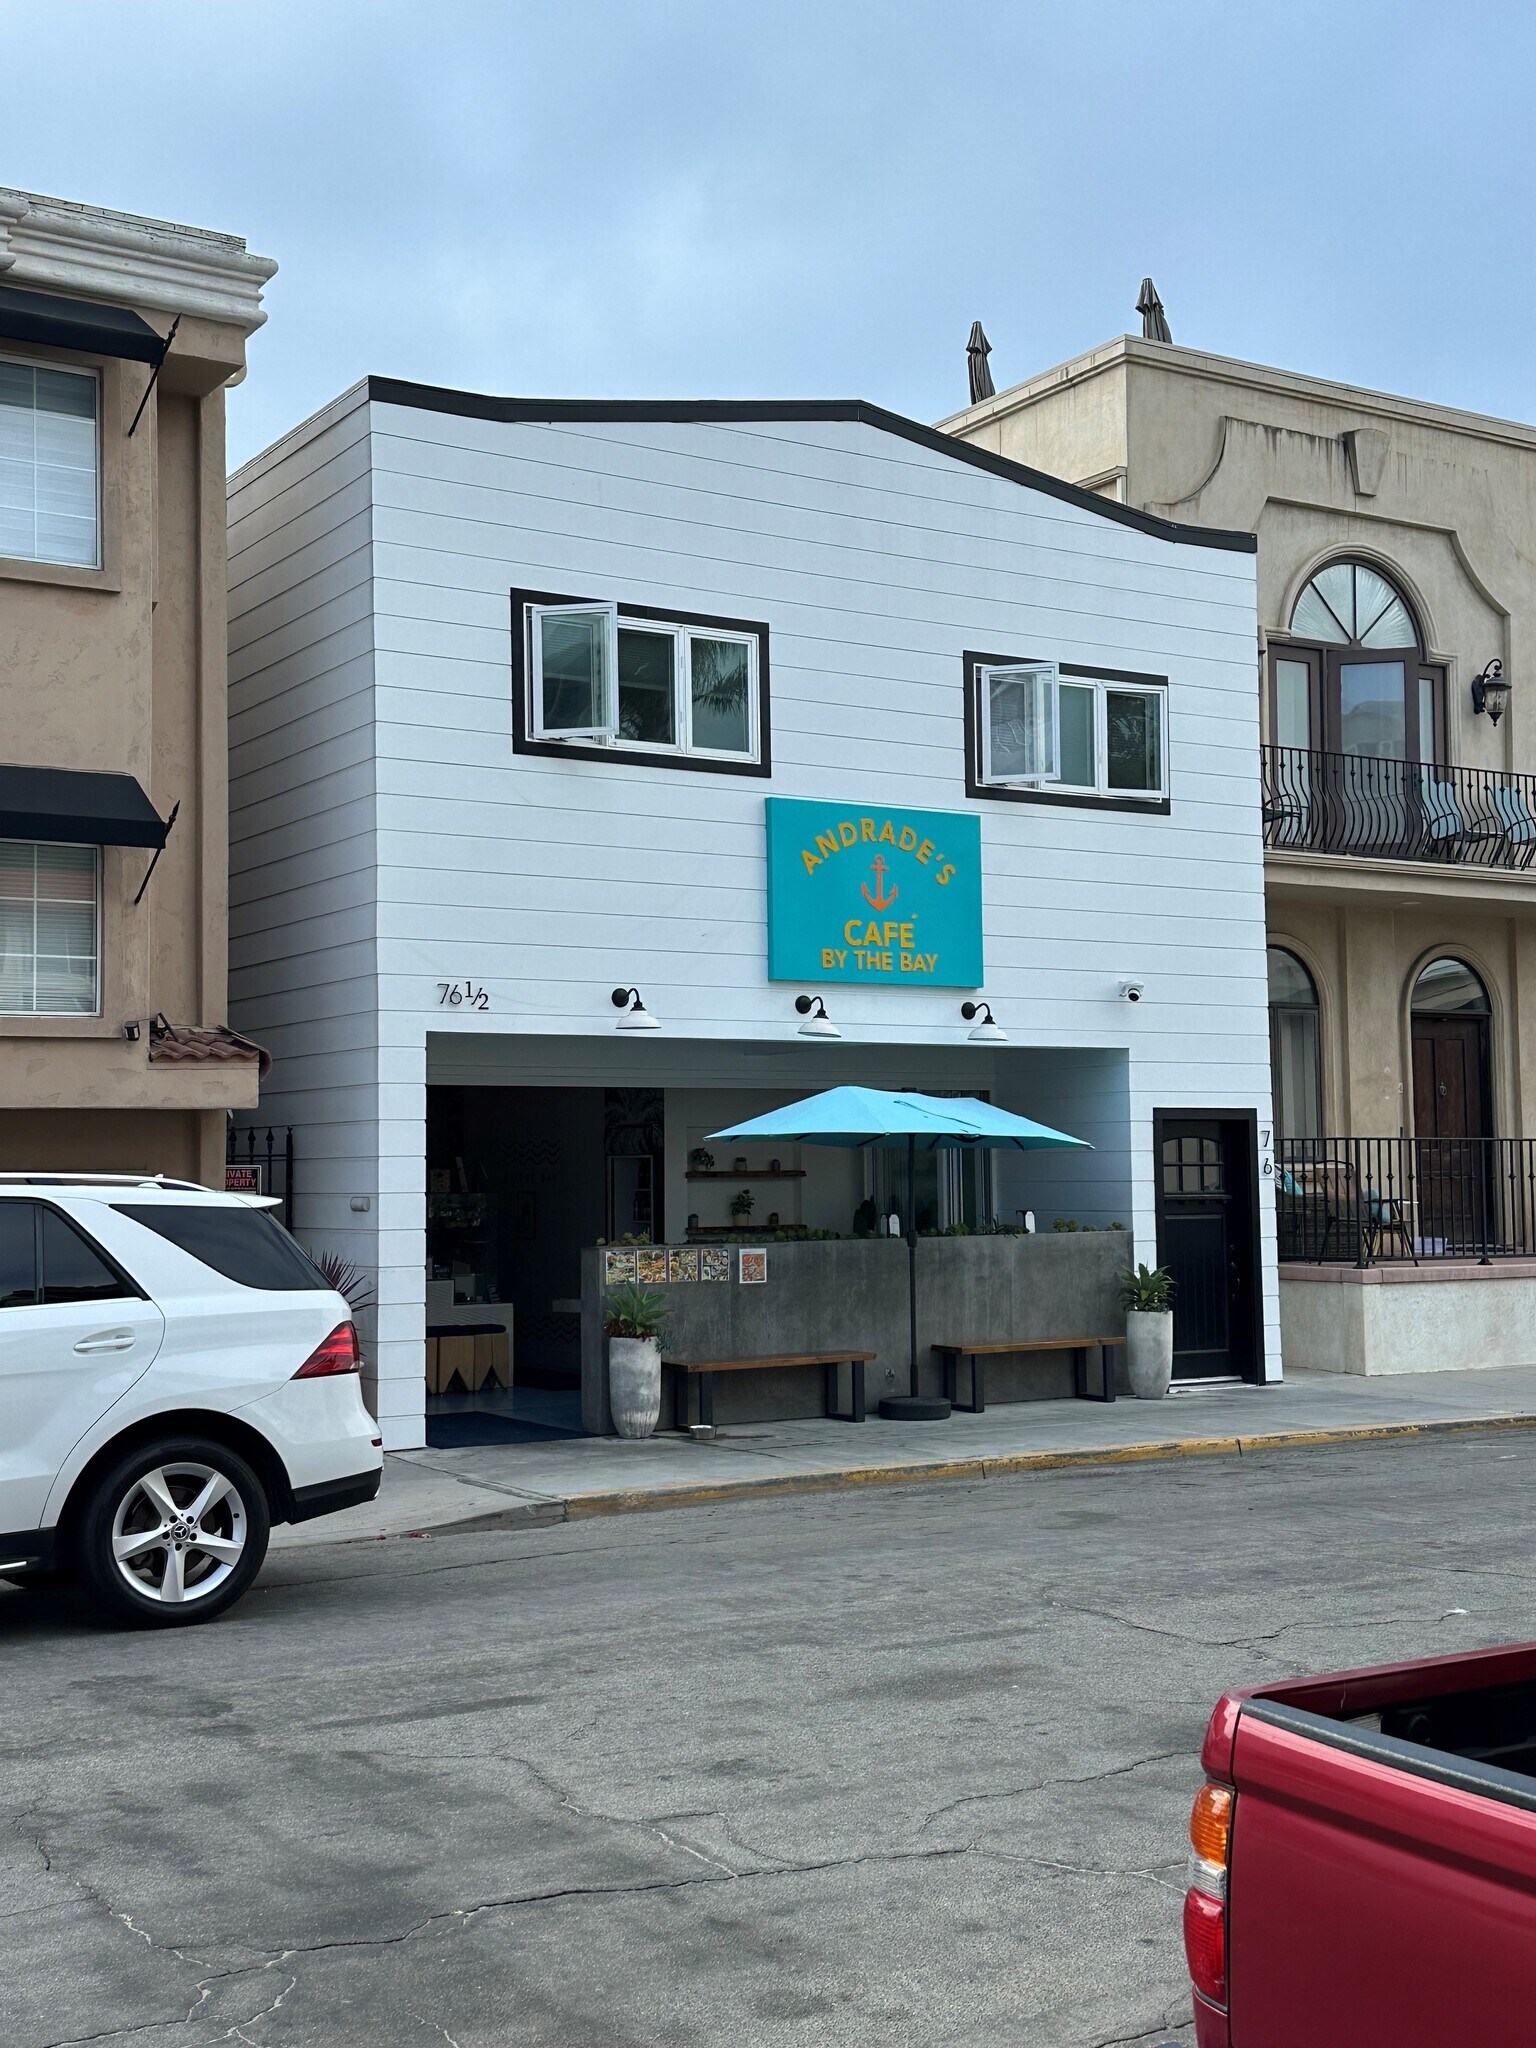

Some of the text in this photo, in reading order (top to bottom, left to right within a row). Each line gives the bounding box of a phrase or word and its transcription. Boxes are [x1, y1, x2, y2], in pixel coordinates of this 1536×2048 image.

[801, 818, 956, 886] ANDRADE'S
[821, 948, 938, 972] BY THE BAY
[227, 1170, 252, 1178] IVATE
